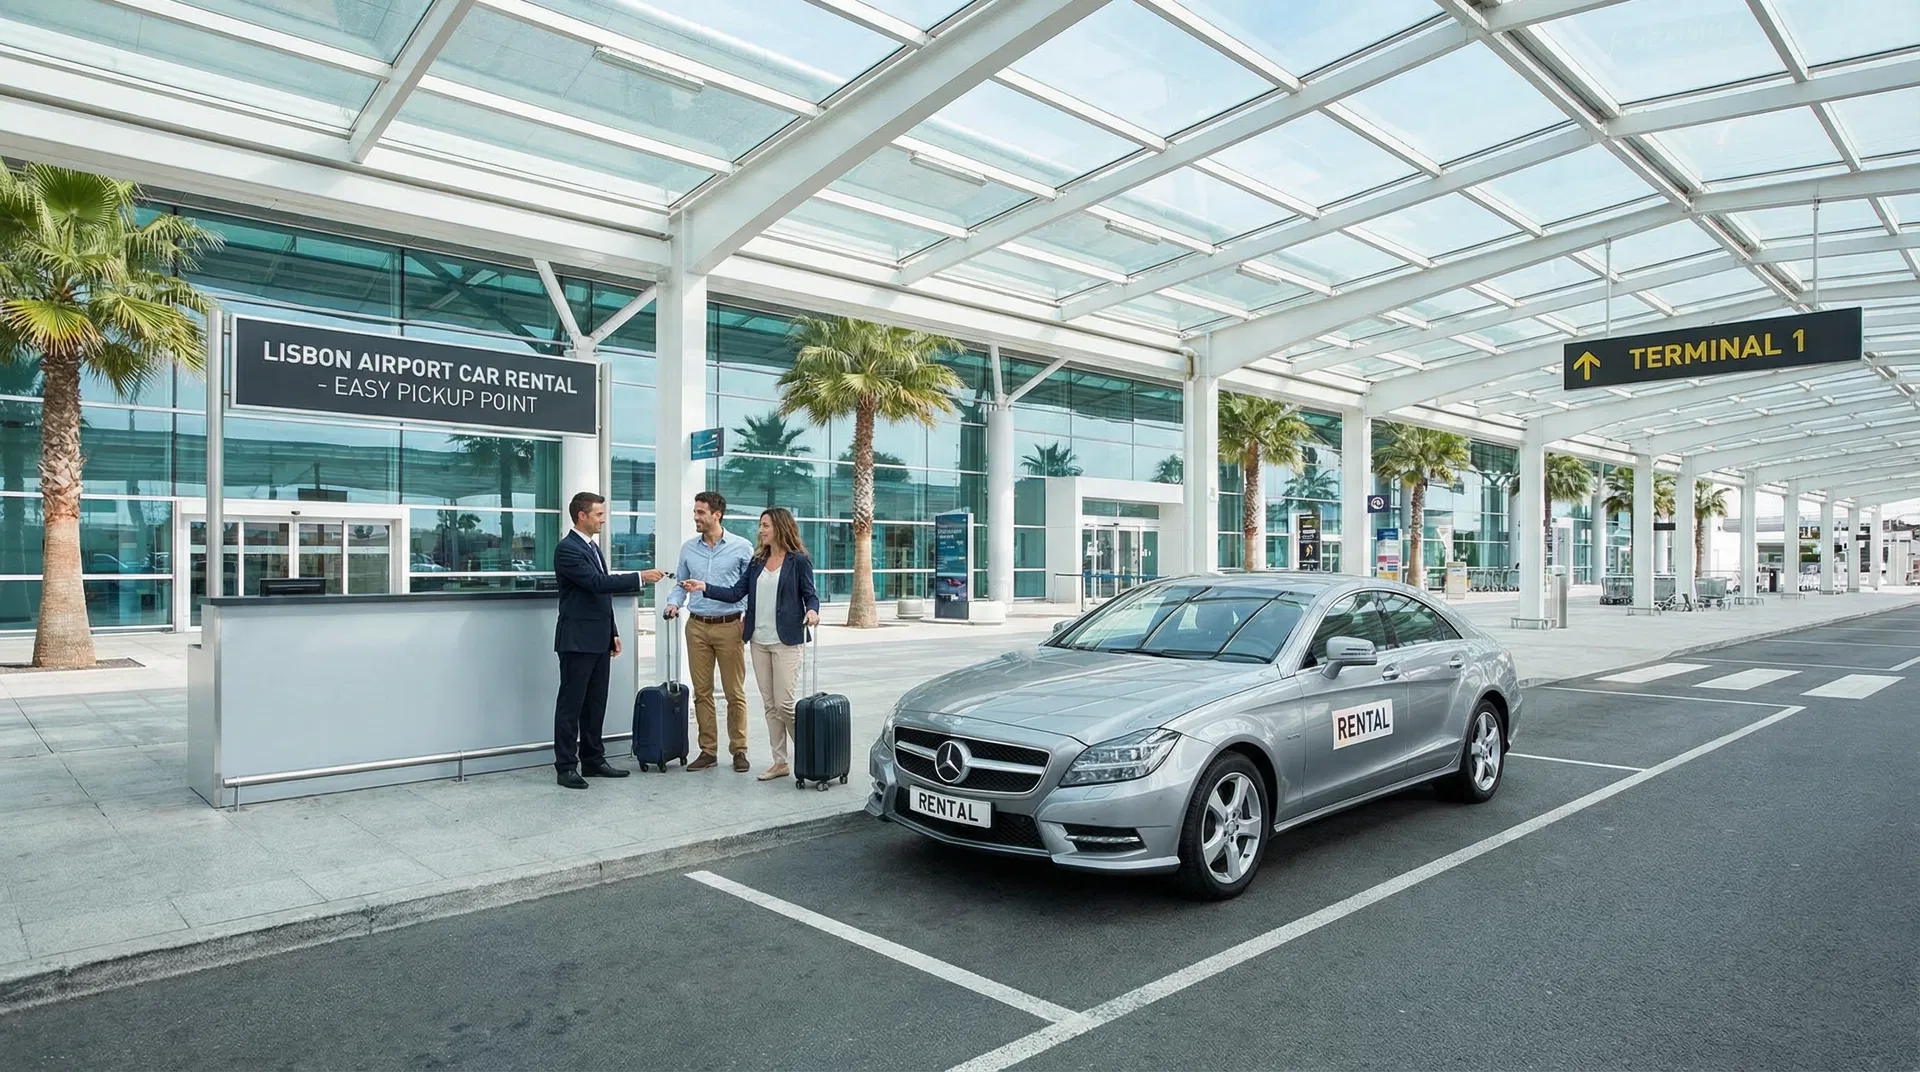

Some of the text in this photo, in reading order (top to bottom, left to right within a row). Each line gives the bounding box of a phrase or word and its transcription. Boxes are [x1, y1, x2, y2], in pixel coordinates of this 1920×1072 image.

[264, 341, 577, 395] LISBON AIRPORT CAR RENTAL
[1629, 329, 1805, 370] TERMINAL 1
[335, 376, 391, 399] EASY
[398, 382, 475, 407] PICKUP
[480, 391, 538, 414] POINT
[1338, 707, 1390, 741] RENTAL
[918, 792, 979, 822] RENTAL
